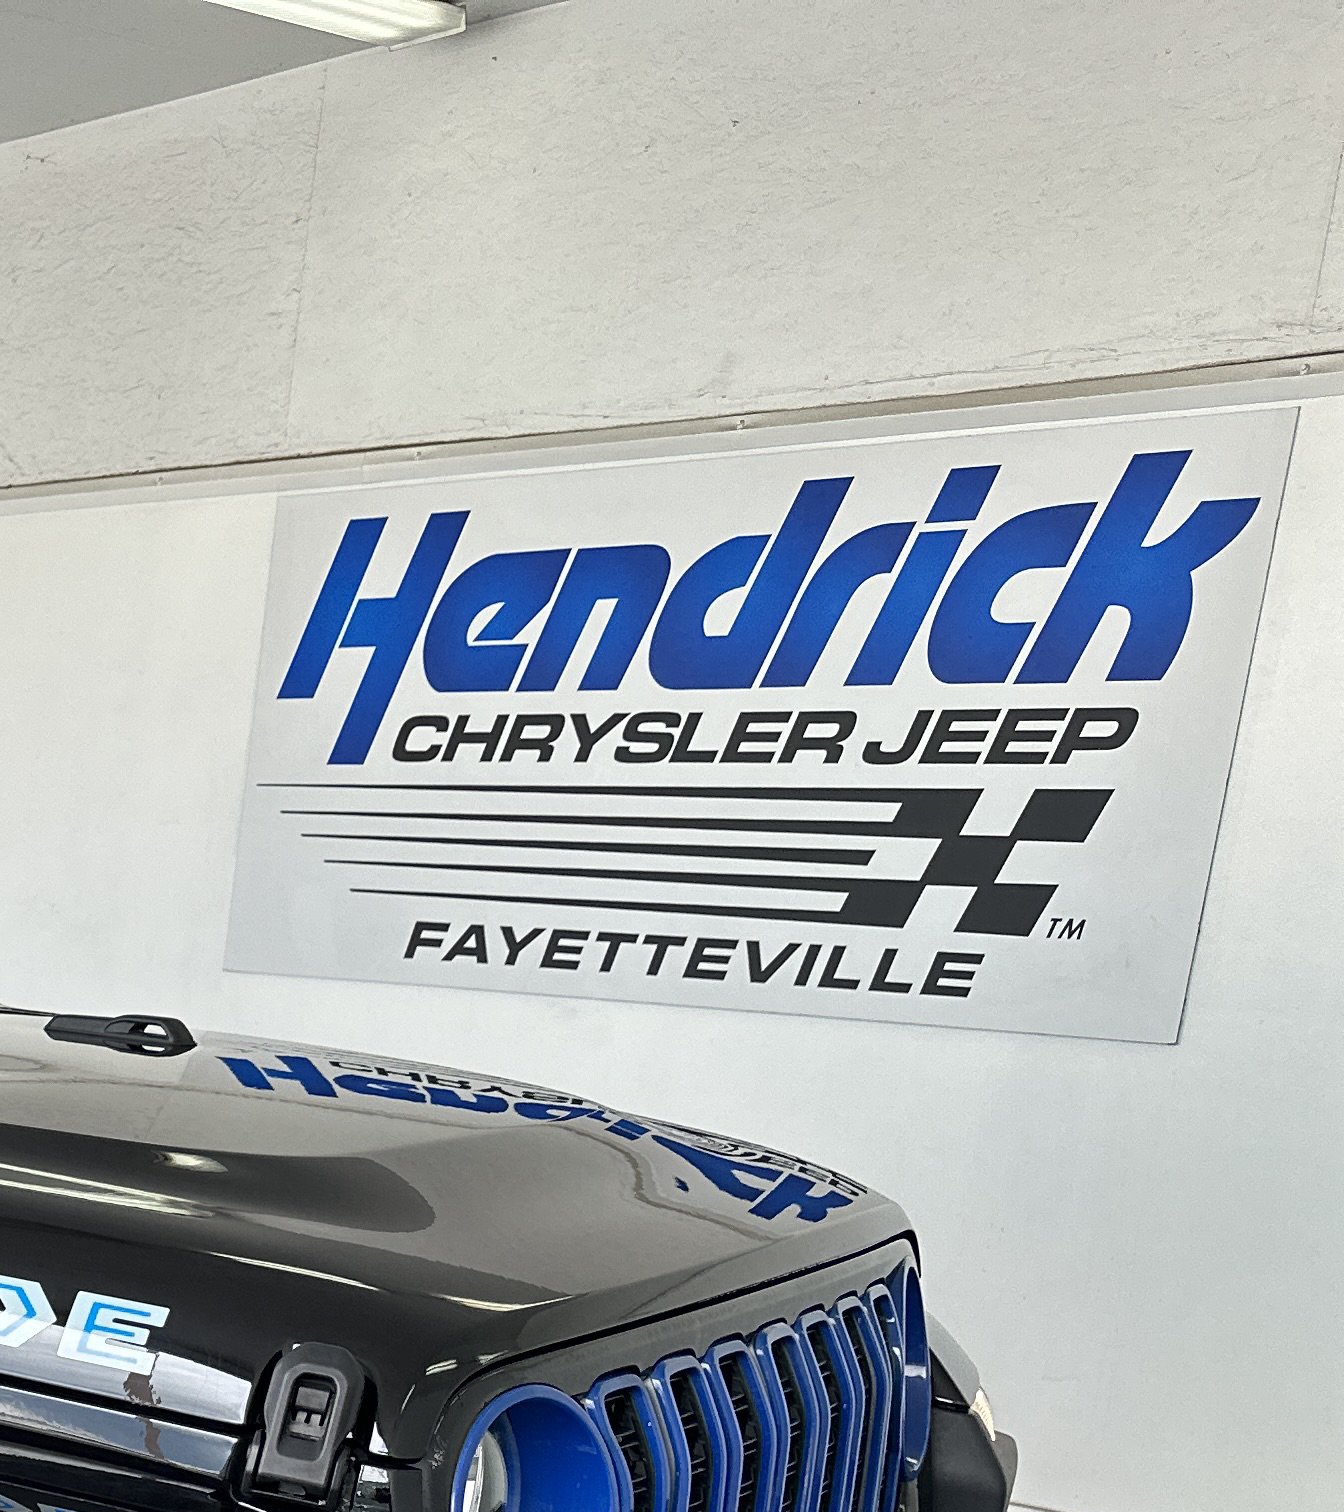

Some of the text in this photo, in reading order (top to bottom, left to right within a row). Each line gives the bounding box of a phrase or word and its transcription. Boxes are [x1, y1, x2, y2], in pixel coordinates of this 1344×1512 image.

[276, 449, 1262, 766] Hendrick
[391, 707, 1140, 765] CHRYSLER JEEP
[404, 921, 986, 999] FAYETTEVILLE
[1047, 917, 1086, 942] TM
